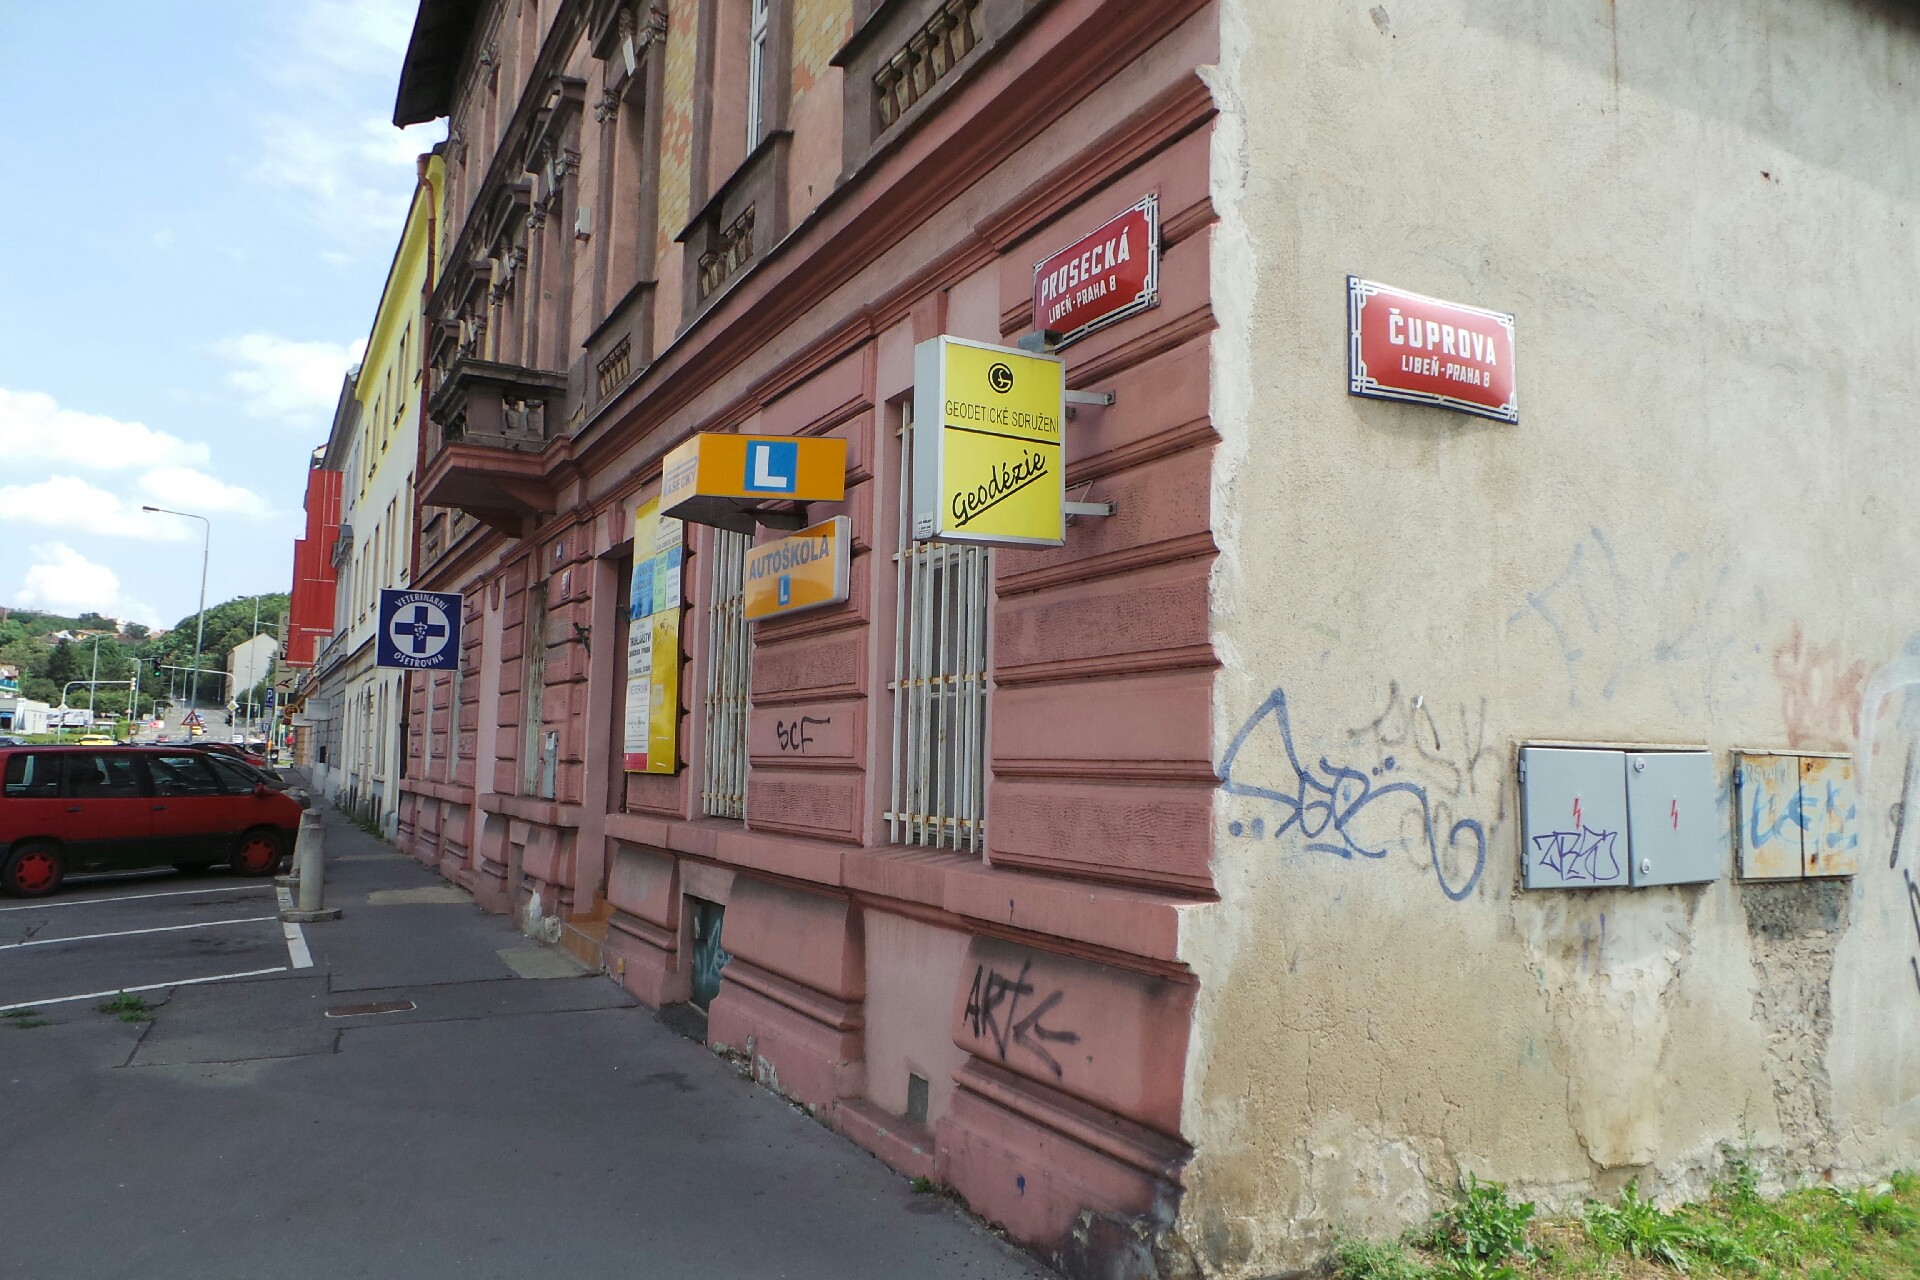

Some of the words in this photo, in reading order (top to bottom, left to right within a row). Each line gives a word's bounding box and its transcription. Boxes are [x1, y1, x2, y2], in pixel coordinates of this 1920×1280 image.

[1041, 226, 1130, 307] PROSECKÁ
[1109, 274, 1116, 291] 8
[1388, 307, 1497, 366] ČUPROVA
[1483, 371, 1490, 388] 8
[945, 400, 1009, 426] GEODETICKÉ
[1011, 411, 1060, 434] SDRUŽENÍ
[753, 445, 787, 488] L
[952, 449, 1046, 526] Geodézie
[749, 534, 830, 581] AUTOŠKOLA
[394, 593, 450, 611] VETERINÁRNÍ
[779, 578, 788, 602] L
[393, 652, 444, 668] OŠETŘOVNA
